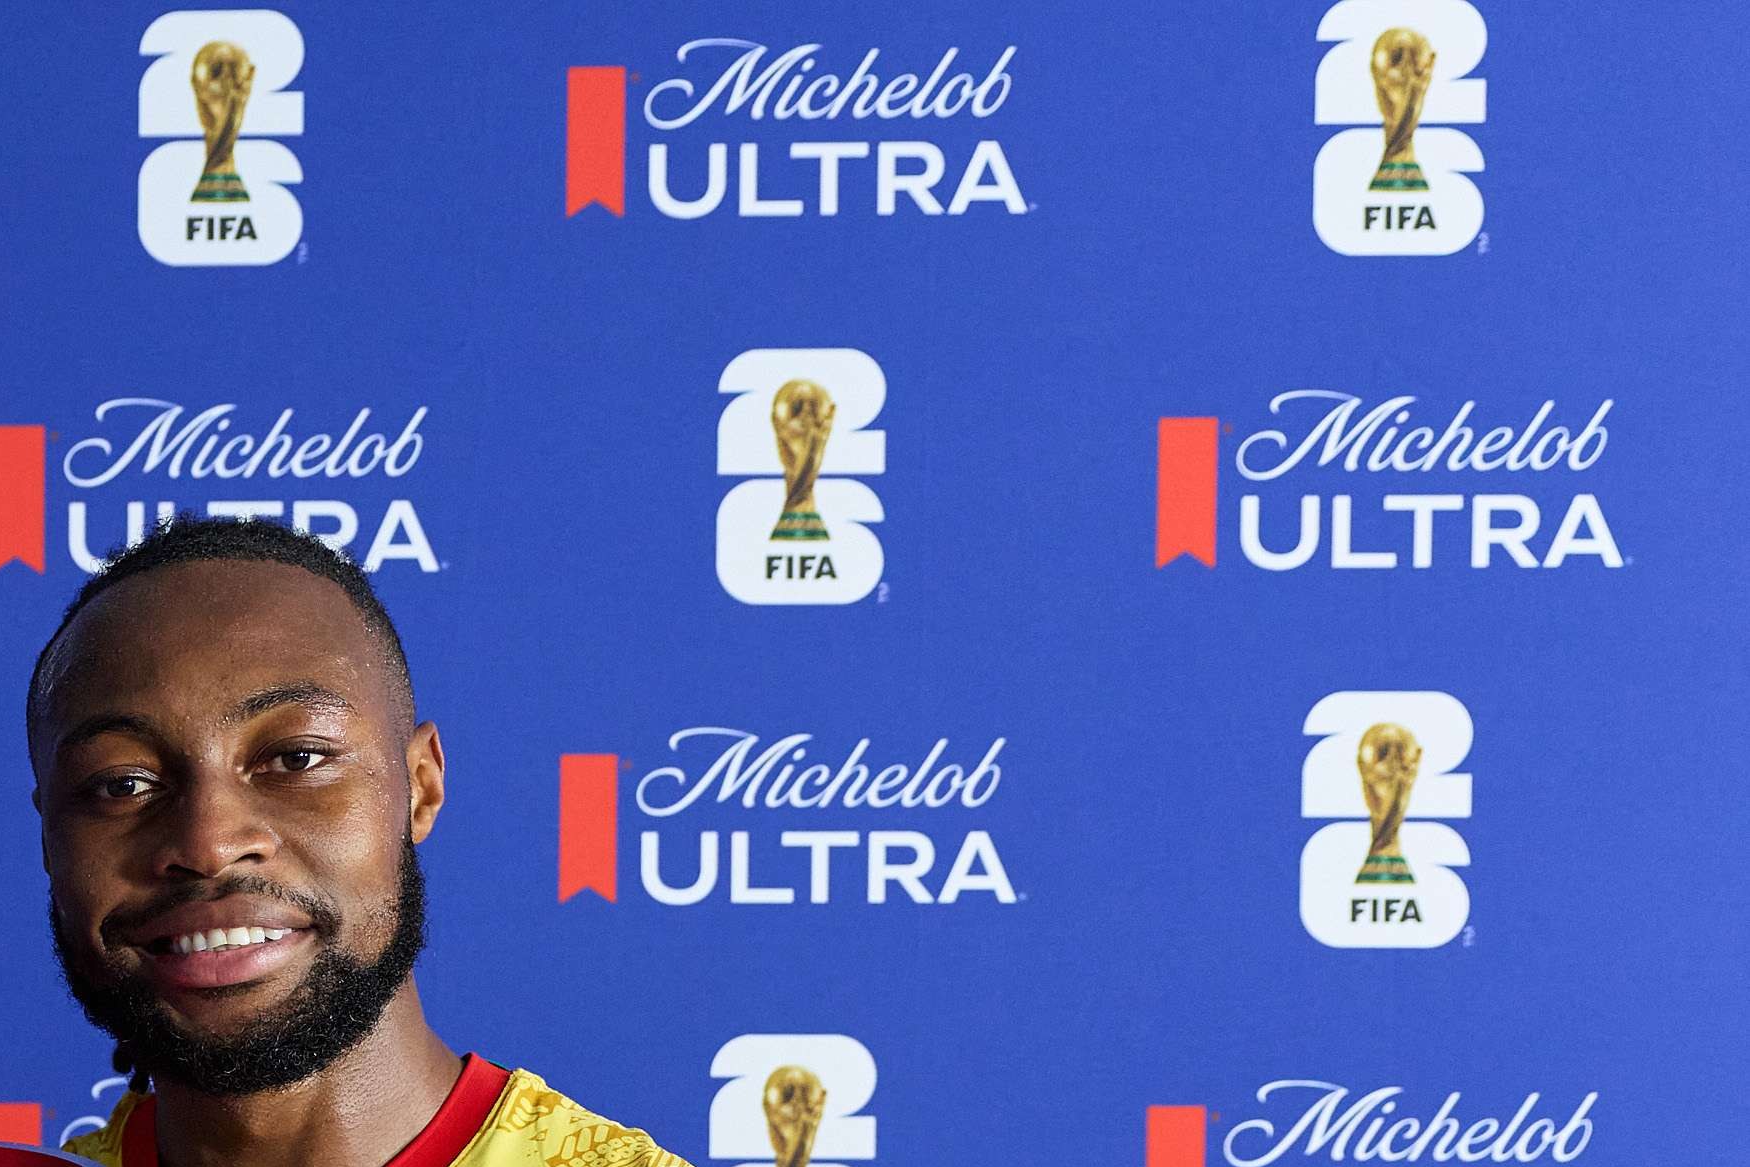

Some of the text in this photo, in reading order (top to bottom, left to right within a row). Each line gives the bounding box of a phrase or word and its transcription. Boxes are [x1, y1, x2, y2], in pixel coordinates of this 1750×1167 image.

[644, 39, 1016, 129] Michelob
[649, 141, 1027, 219] ULTRA
[187, 217, 257, 241] FIFA
[1364, 206, 1436, 230] FIFA
[64, 398, 427, 487] Michelob
[1236, 390, 1613, 480] Michelob
[68, 500, 440, 573] URA
[766, 556, 836, 579] FIFA
[1240, 494, 1623, 570] ULTRA
[636, 727, 1006, 817] Michelob
[641, 831, 1016, 905] ULTRA
[1351, 899, 1422, 922] FIFA
